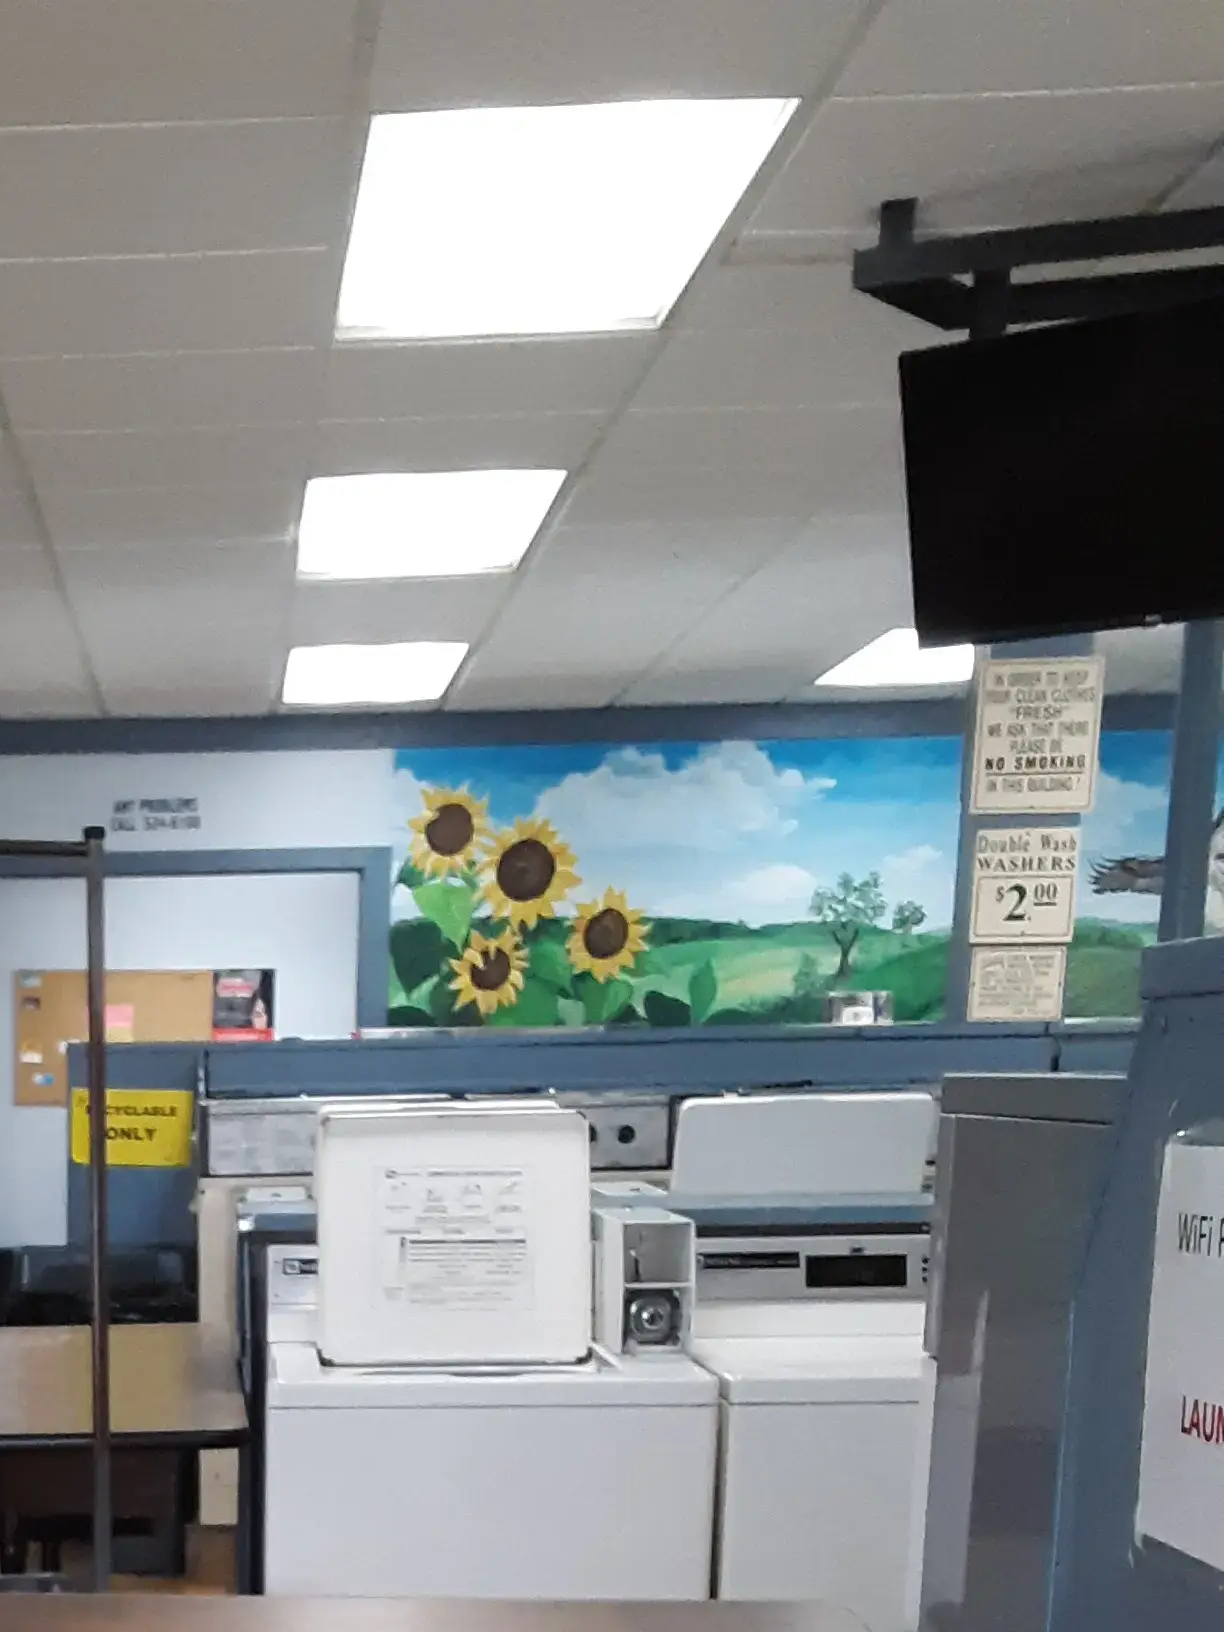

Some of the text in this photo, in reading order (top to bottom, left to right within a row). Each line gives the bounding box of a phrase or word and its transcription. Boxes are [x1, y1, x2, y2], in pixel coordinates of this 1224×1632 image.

[984, 754, 1086, 770] NO SMOKING
[978, 832, 1077, 853] Double Wash
[976, 855, 1076, 872] WASHERS
[104, 1126, 157, 1141] ONLY
[1178, 1212, 1214, 1257] WiFi
